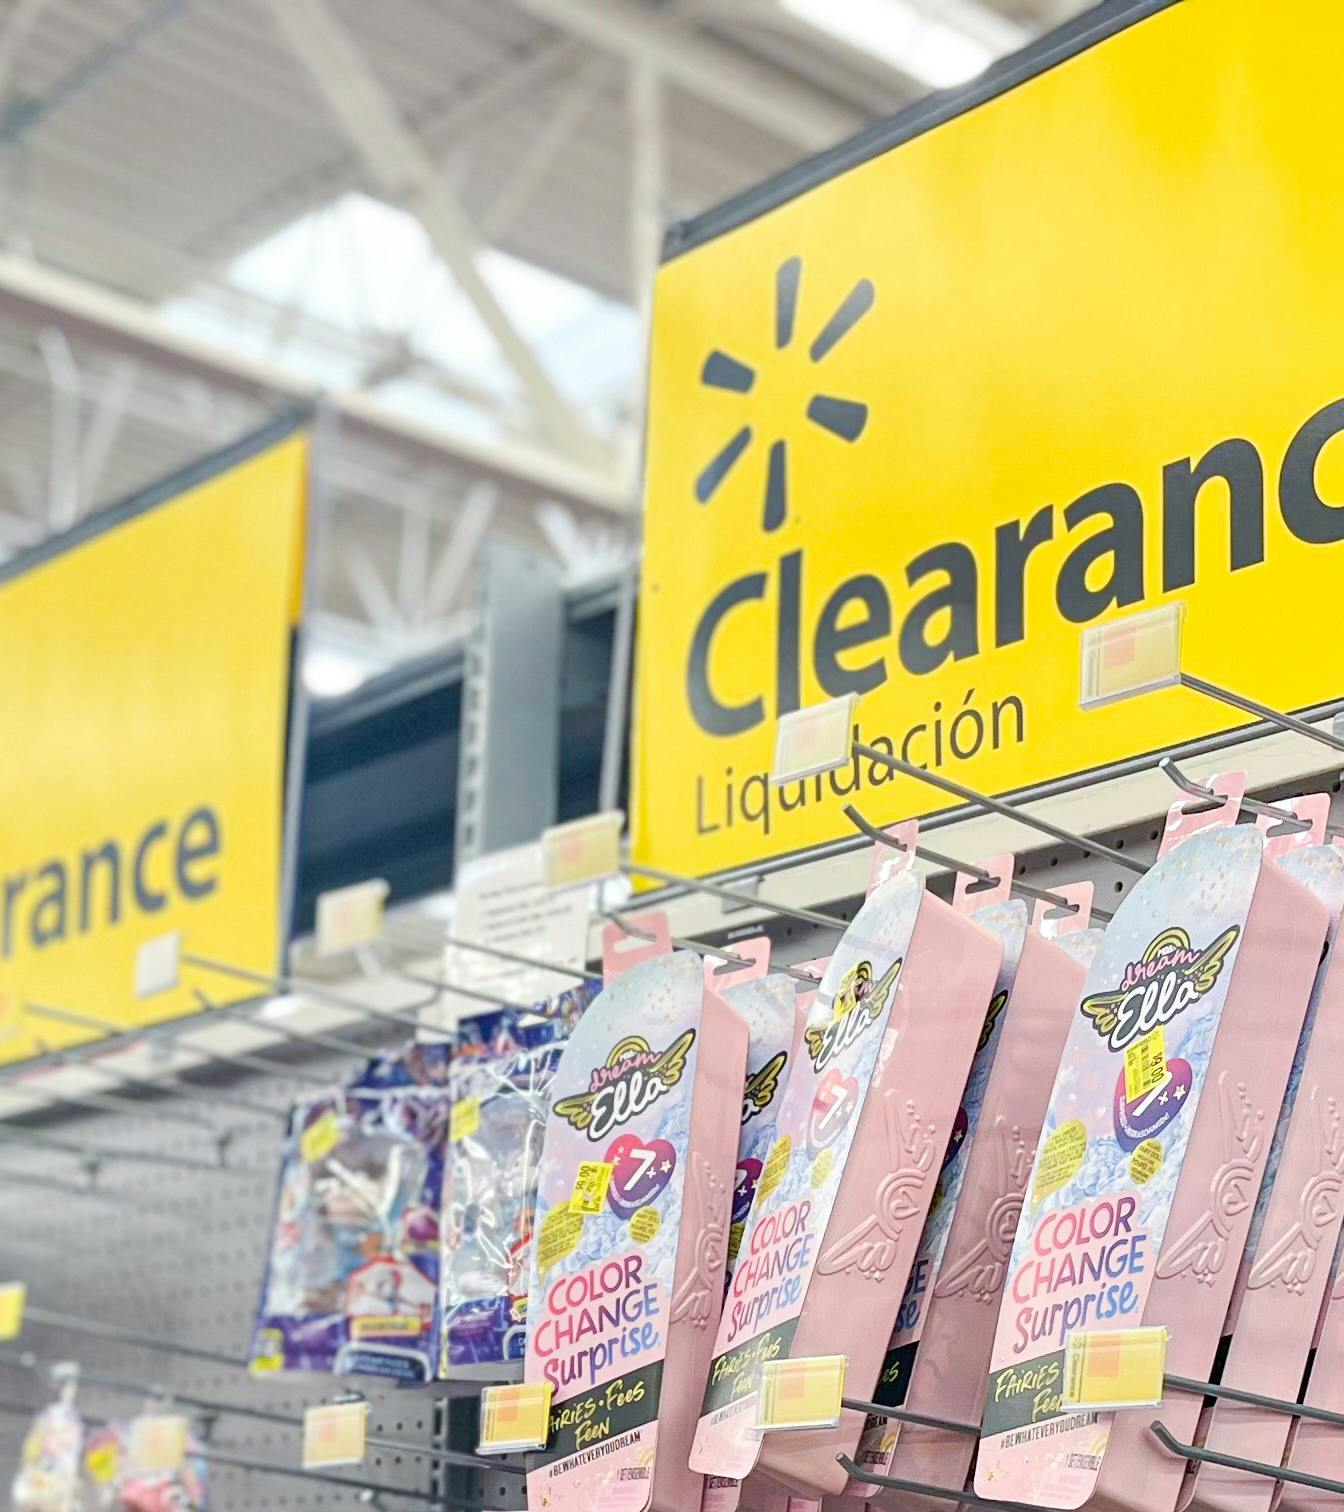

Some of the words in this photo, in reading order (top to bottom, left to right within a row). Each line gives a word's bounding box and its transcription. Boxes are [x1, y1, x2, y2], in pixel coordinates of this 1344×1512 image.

[1121, 947, 1203, 991] dream
[814, 1000, 873, 1074] Ella
[1109, 971, 1200, 1049] Ella
[589, 1051, 662, 1093] dream
[590, 1069, 668, 1139] Ella
[750, 1199, 812, 1256] COLOR
[1034, 1196, 1136, 1257] COLOR
[547, 1254, 643, 1316] COLOR
[733, 1233, 815, 1298] CHANGE
[1012, 1233, 1147, 1305] CHANGE
[533, 1282, 661, 1359] CHANGE
[727, 1273, 803, 1343] Surprise
[1012, 1279, 1140, 1354] Surprise
[543, 1320, 660, 1399] Surprise
